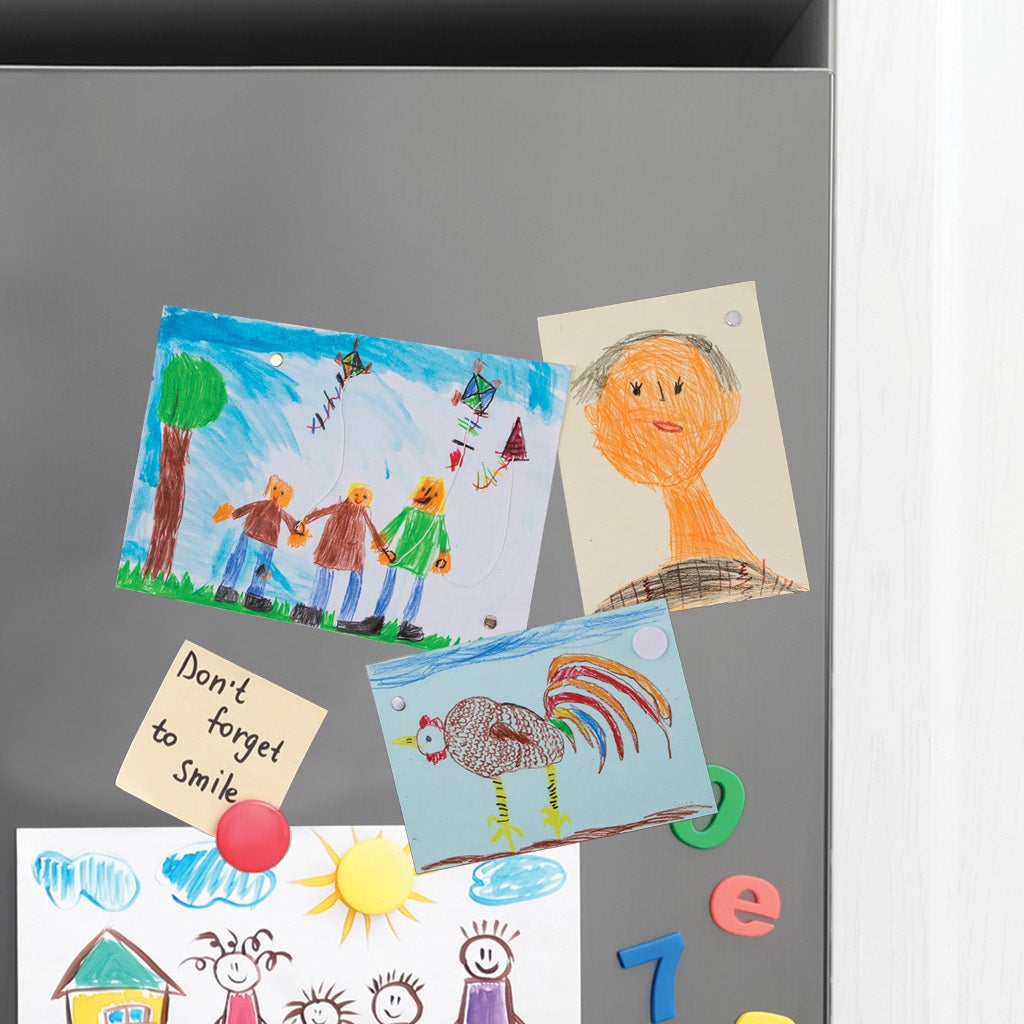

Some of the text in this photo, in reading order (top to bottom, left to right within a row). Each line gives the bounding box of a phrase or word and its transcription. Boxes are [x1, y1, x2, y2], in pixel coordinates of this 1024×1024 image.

[176, 650, 251, 705] Don't
[151, 718, 178, 747] to
[207, 706, 285, 764] forget
[709, 874, 782, 937] e
[616, 931, 686, 1024] 7
